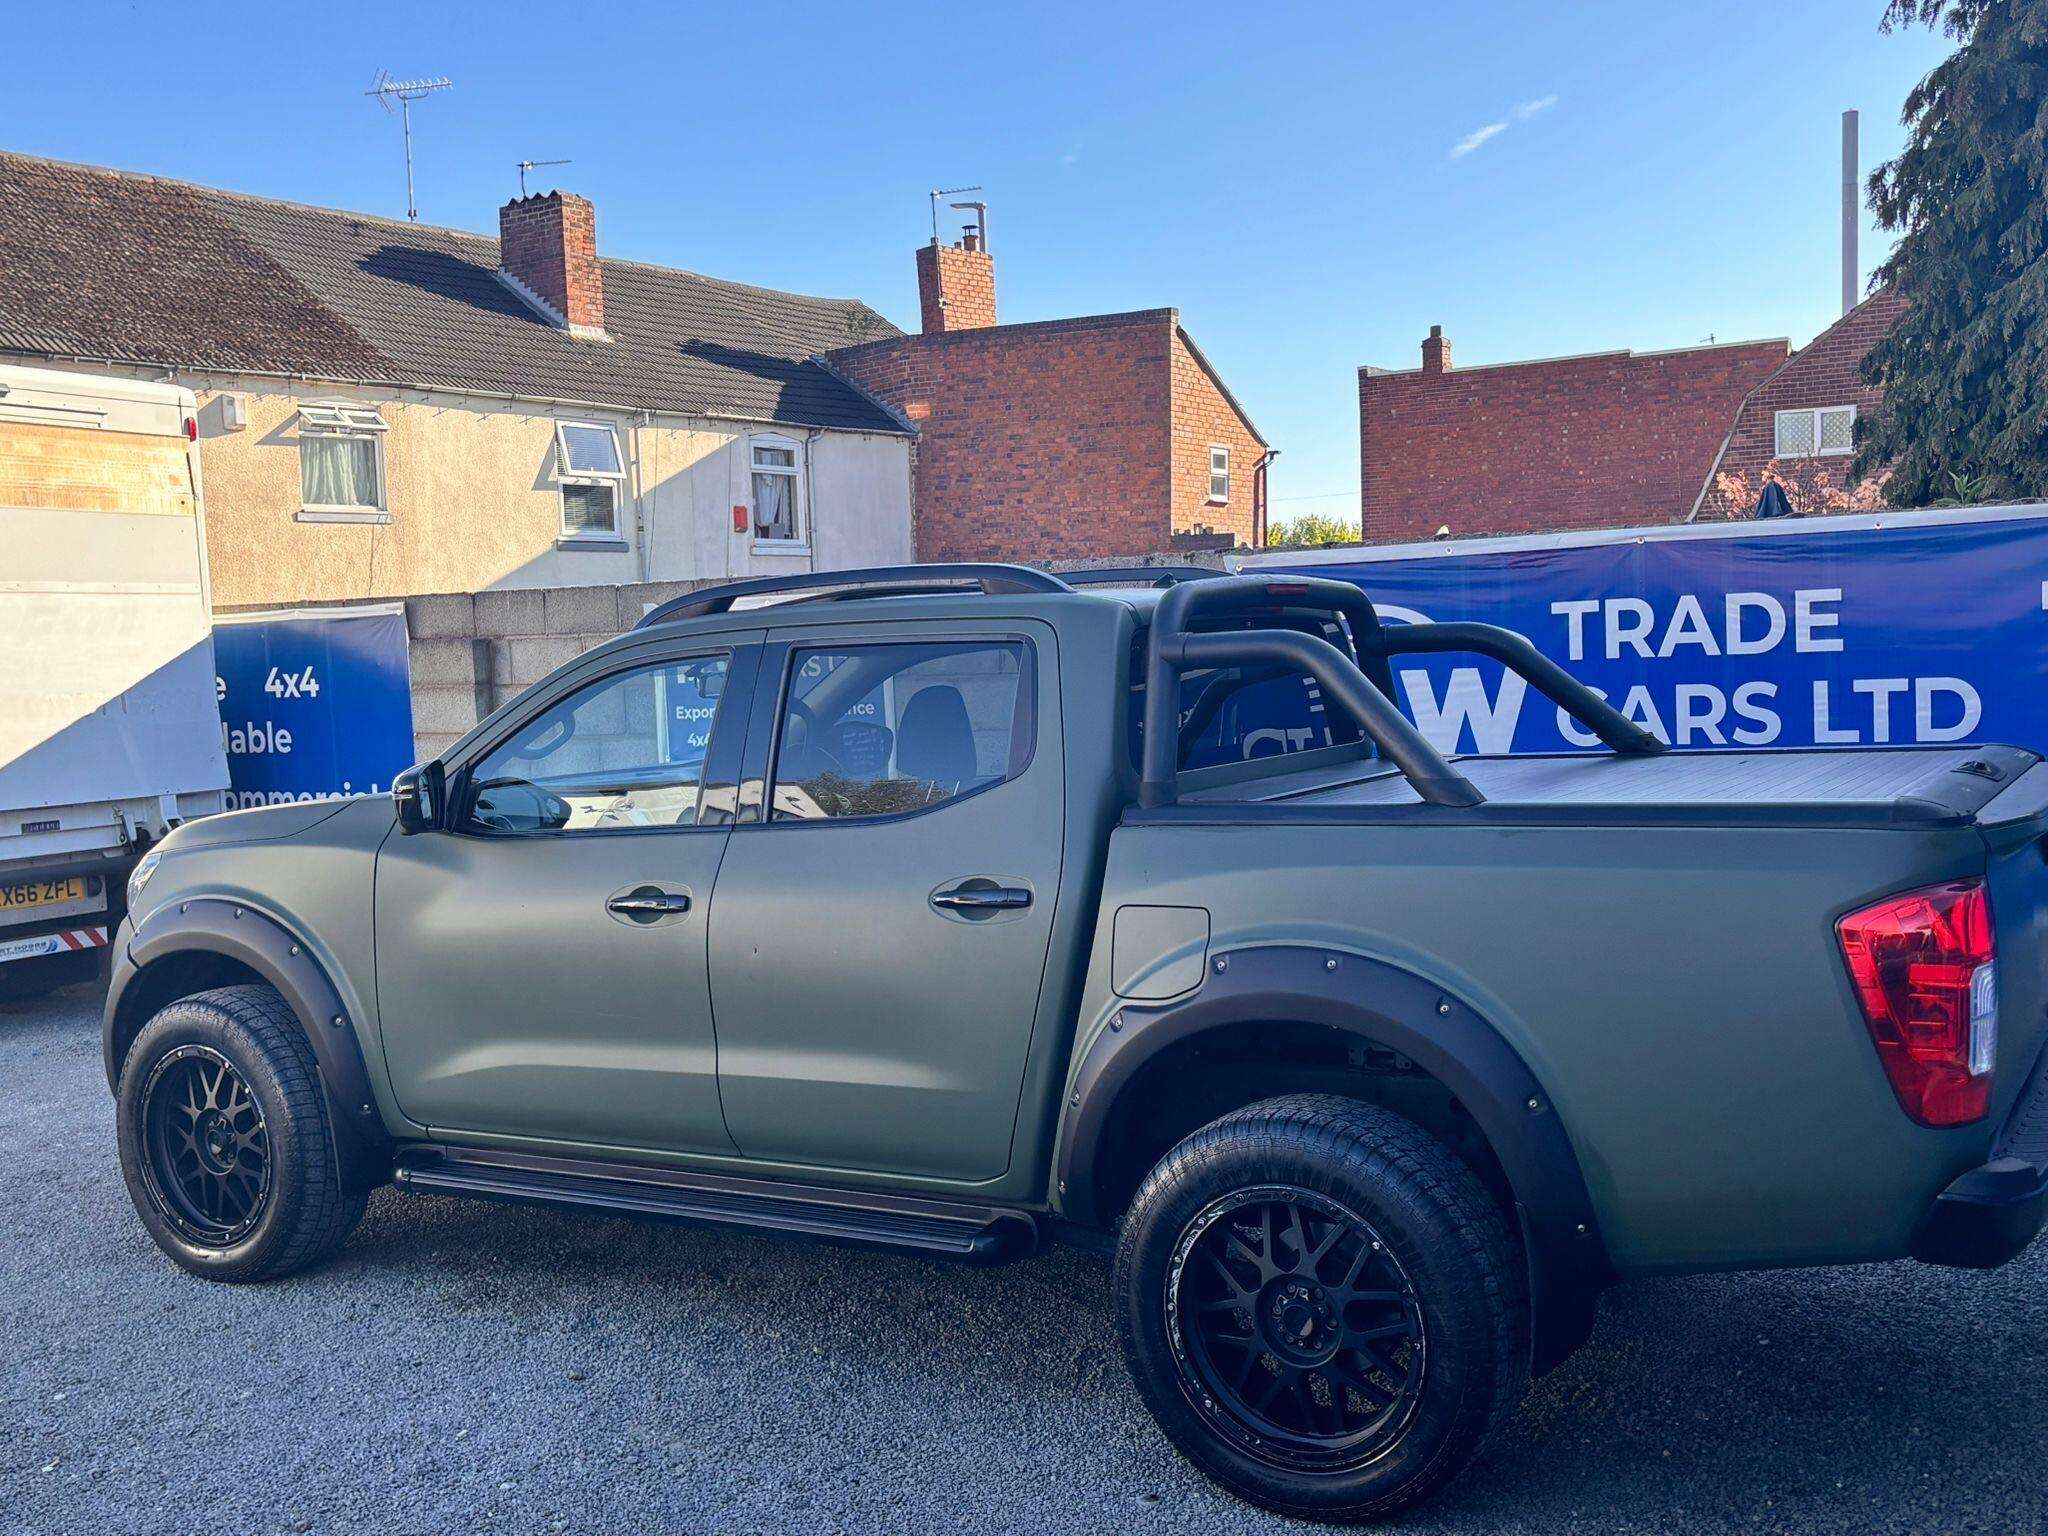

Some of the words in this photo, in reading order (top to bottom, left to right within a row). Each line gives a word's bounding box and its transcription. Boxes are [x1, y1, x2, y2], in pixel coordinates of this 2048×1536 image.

[1550, 588, 1844, 661] TRADE
[265, 666, 320, 698] 4x4
[1400, 667, 1528, 754] W
[1556, 681, 1782, 747] CARS
[1812, 677, 1982, 743] LTD
[0, 885, 38, 906] X66
[44, 879, 77, 900] ZFL
